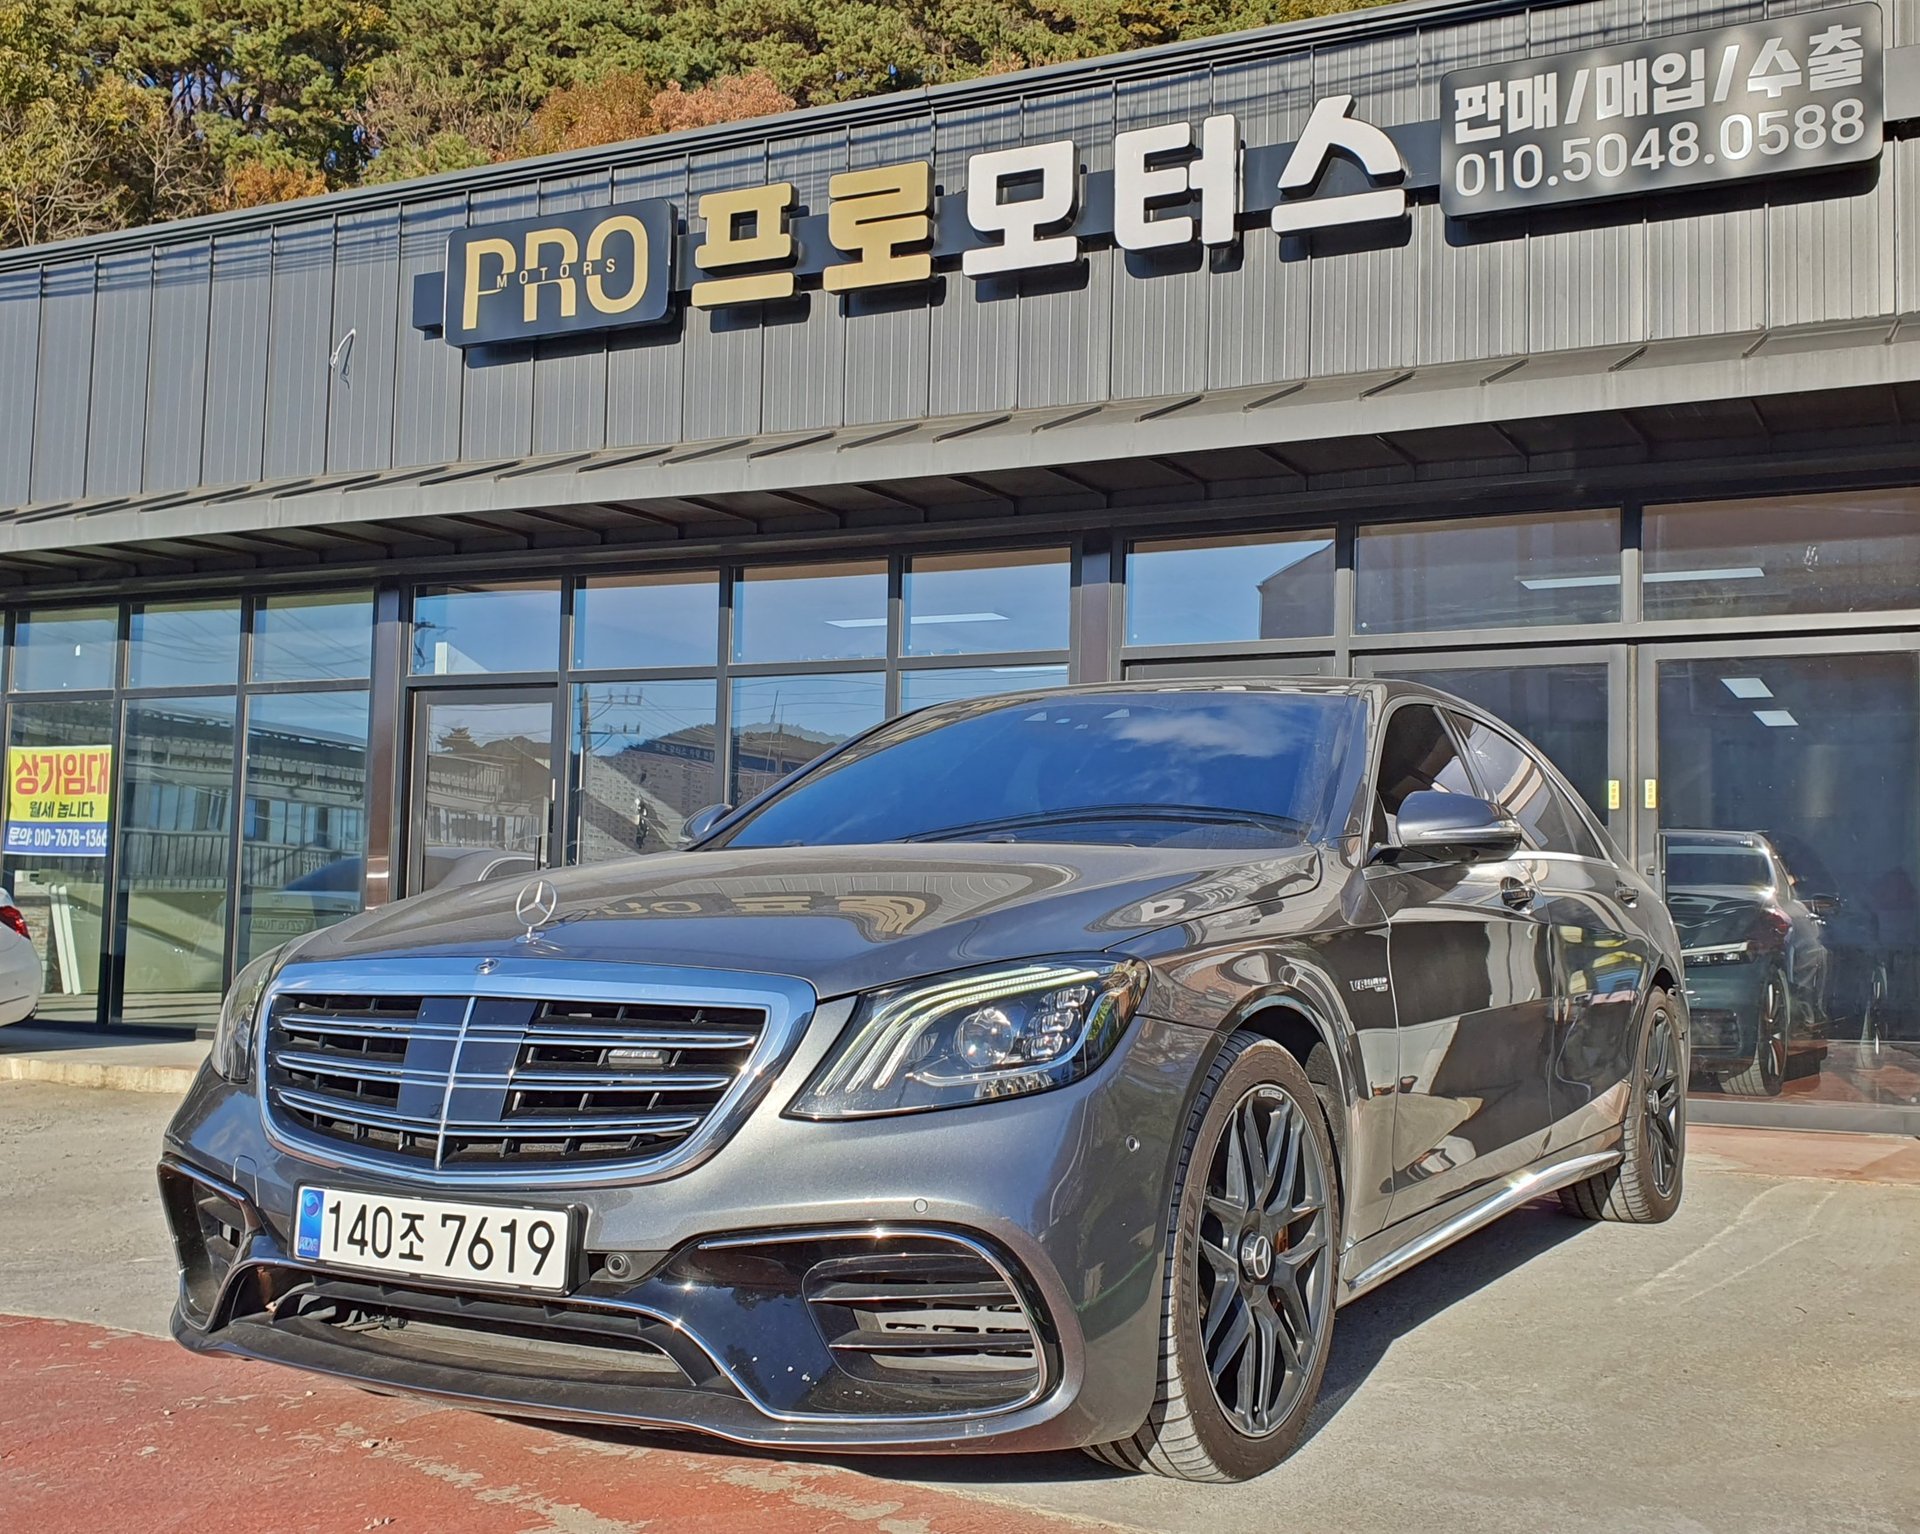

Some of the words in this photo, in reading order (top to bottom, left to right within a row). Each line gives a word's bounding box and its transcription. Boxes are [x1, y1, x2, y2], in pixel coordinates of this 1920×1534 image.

[1454, 24, 1865, 144] 판매/매입/수출
[1455, 98, 1866, 197] 010.5048.0588
[691, 94, 1405, 310] 프로모터스
[462, 215, 649, 330] PRO
[496, 258, 616, 288] MOTORS
[15, 753, 110, 795] 상가임대
[29, 801, 55, 818] 월세
[329, 1200, 424, 1262] 140조
[440, 1213, 555, 1276] 7619
